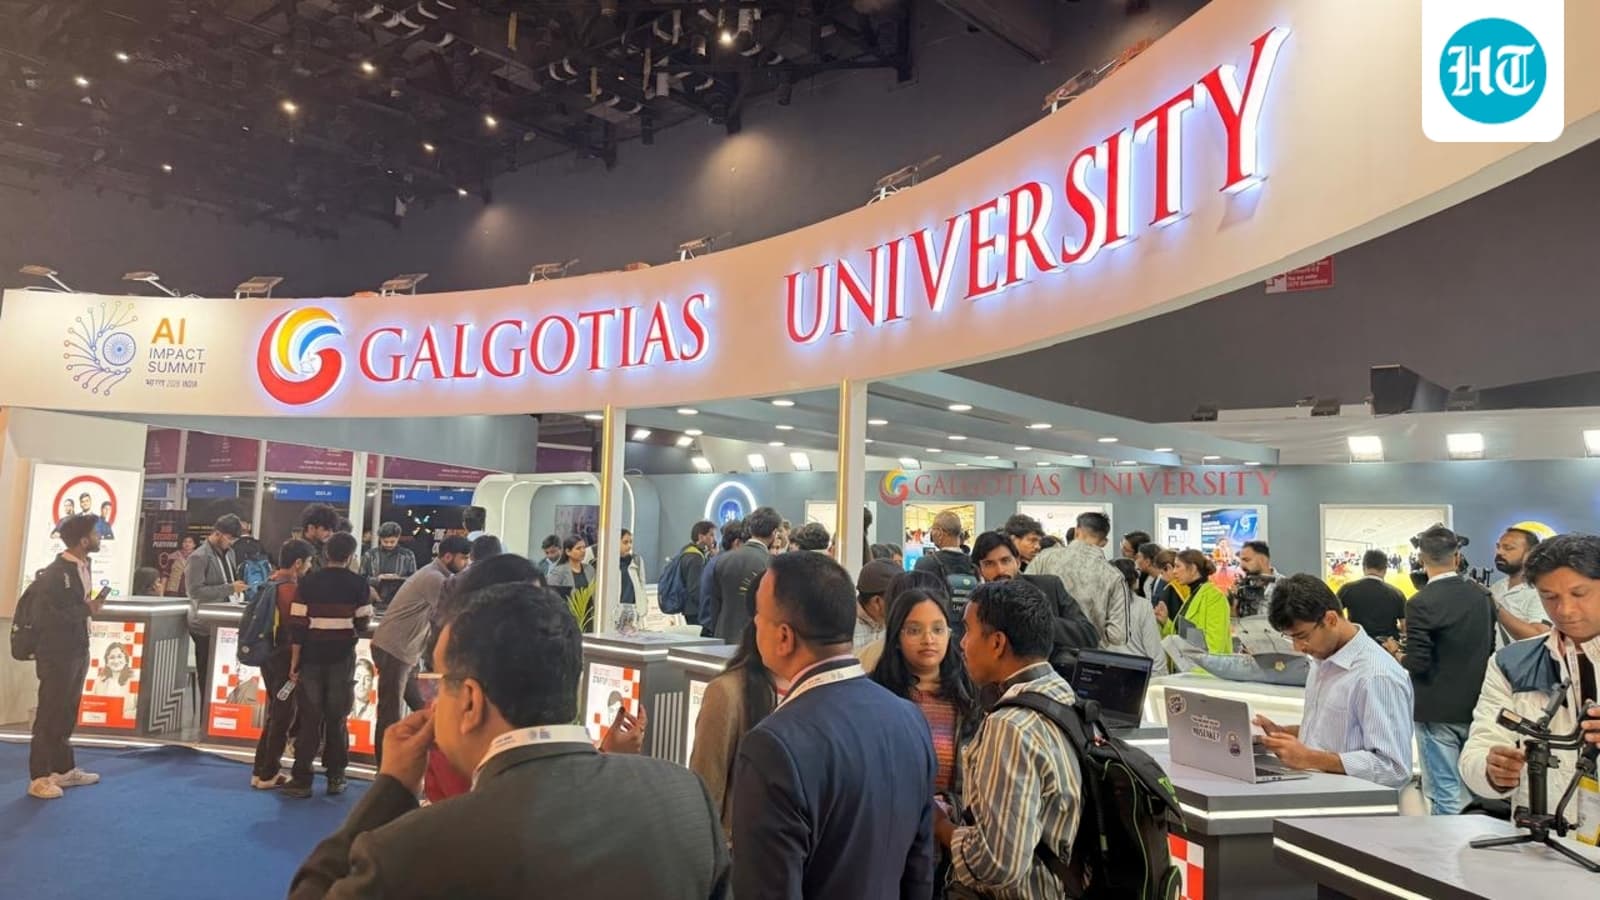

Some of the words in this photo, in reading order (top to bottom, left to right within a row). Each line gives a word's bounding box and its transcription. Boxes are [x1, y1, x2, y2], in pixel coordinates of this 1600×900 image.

[359, 293, 710, 382] GALGOTIAS
[785, 26, 1291, 343] UNIVERSITY
[151, 317, 186, 345] AI
[147, 361, 206, 374] SUMMIT
[149, 348, 205, 361] IMPACT
[913, 472, 1061, 497] GALGOTIAS
[1079, 469, 1278, 497] UNIVERSITY
